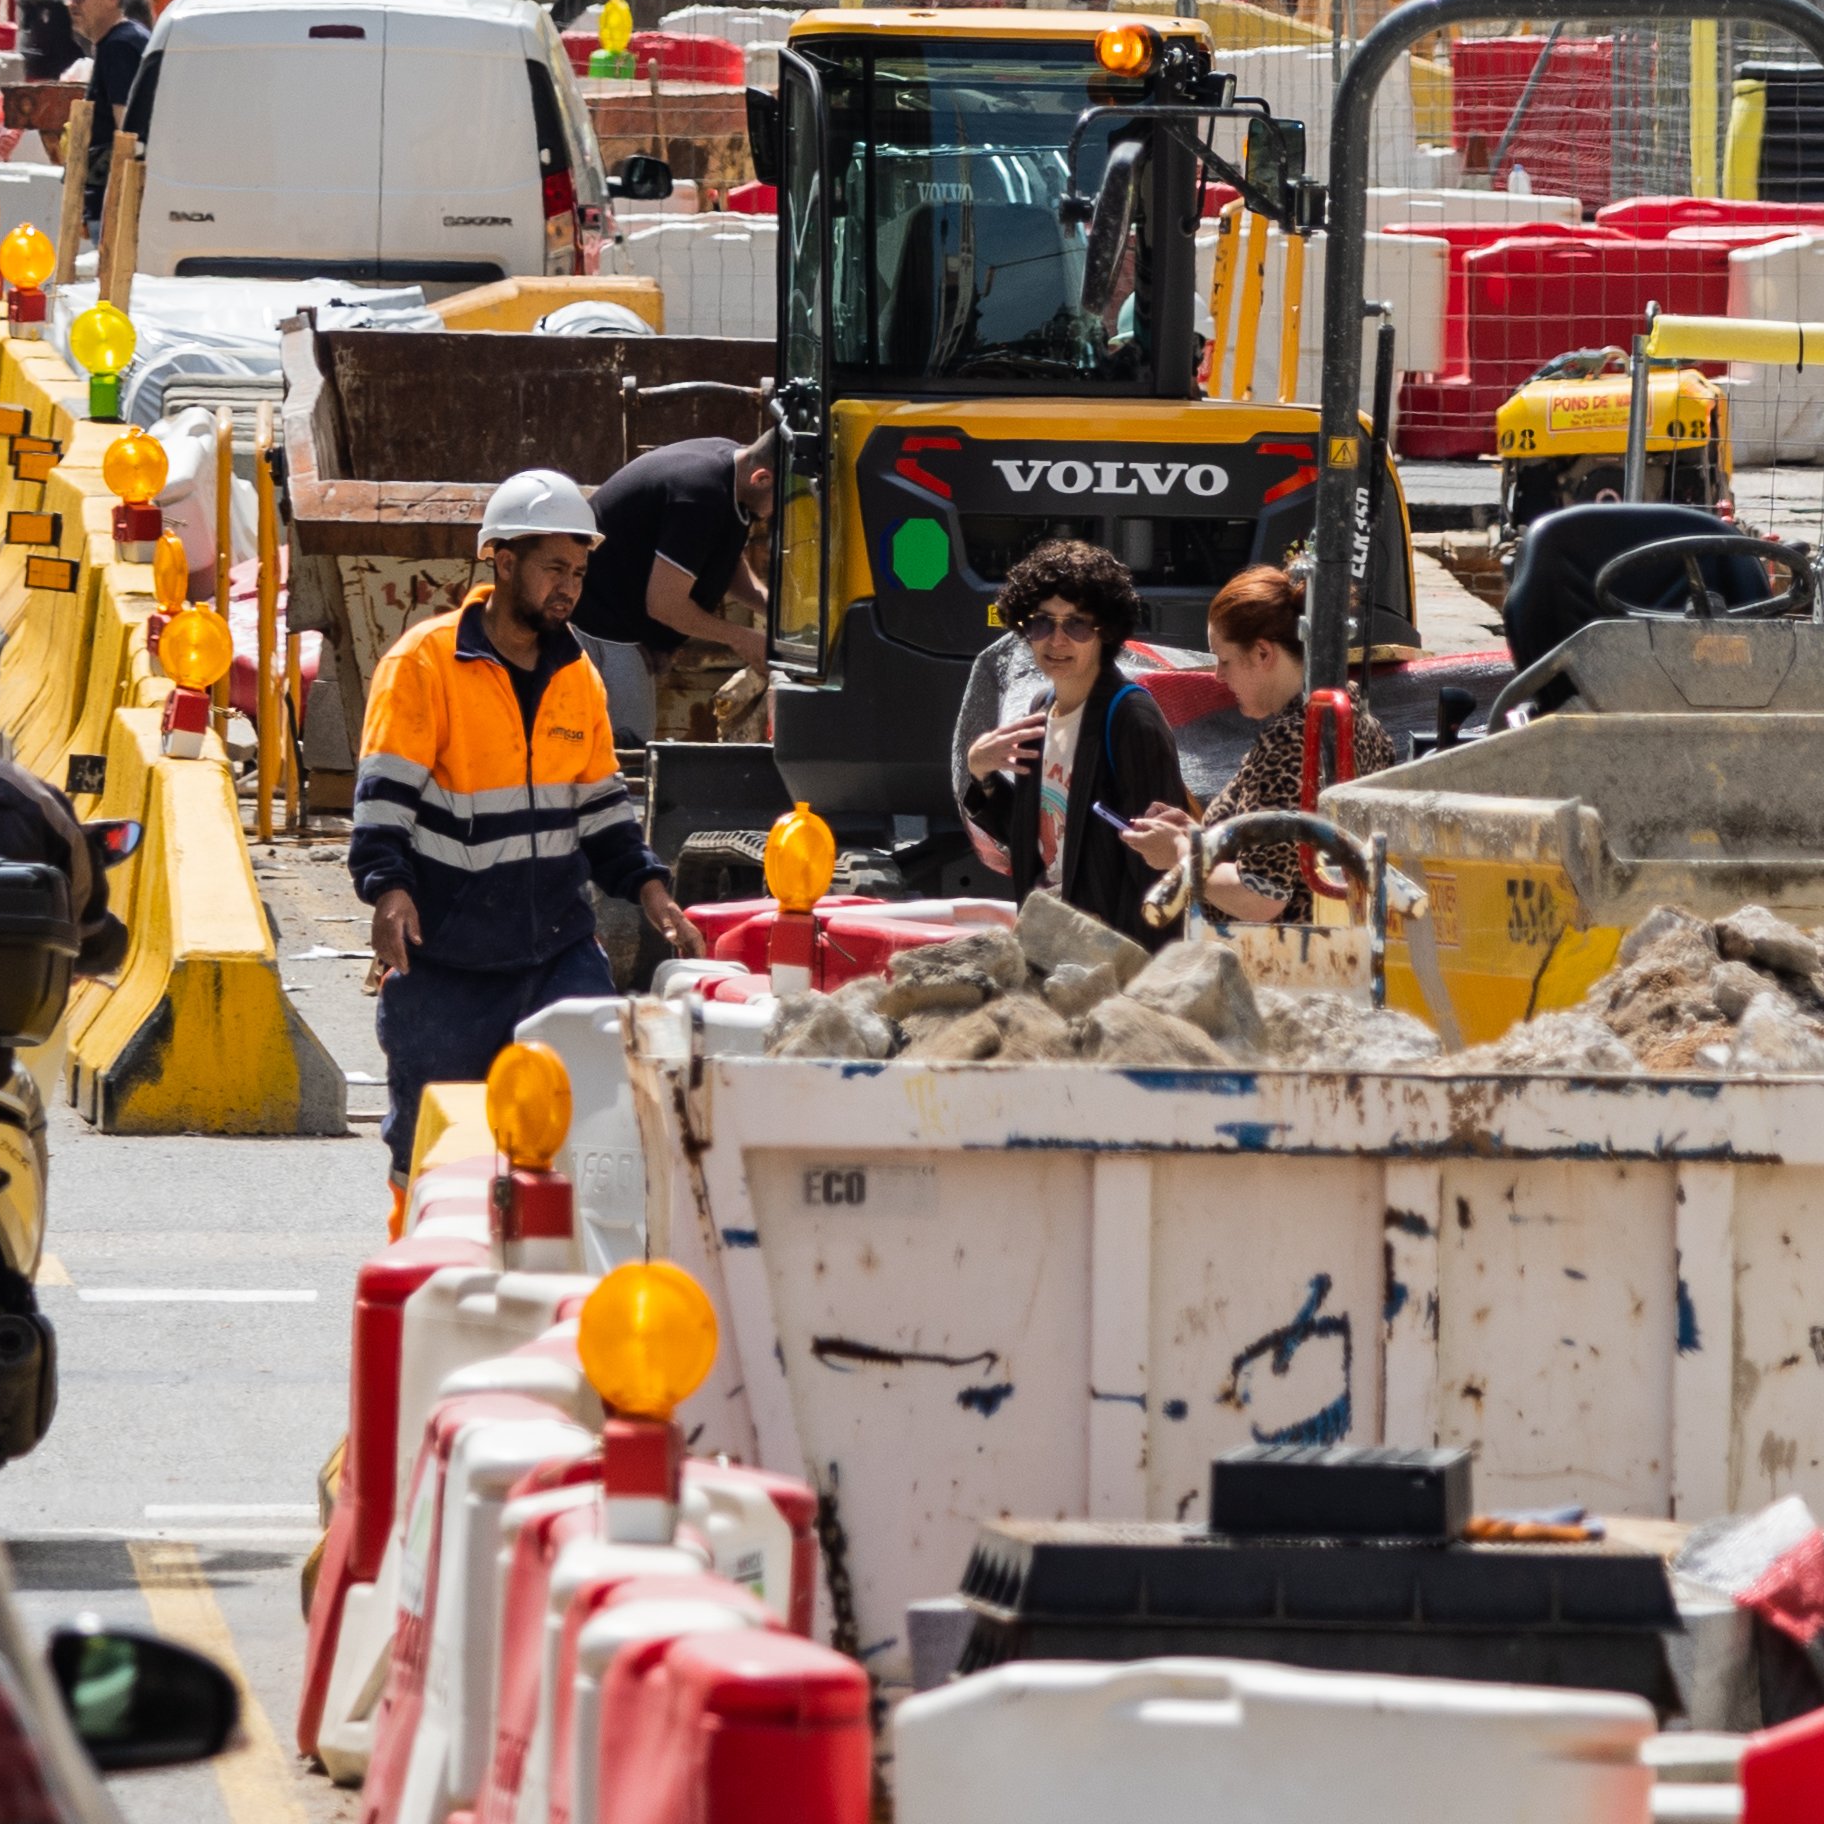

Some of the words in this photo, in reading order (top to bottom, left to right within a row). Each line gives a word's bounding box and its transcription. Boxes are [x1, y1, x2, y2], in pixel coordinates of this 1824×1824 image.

[1554, 396, 1589, 412] PONS
[1593, 395, 1609, 408] DE
[1501, 429, 1537, 451] 08
[1667, 419, 1707, 439] 08
[992, 458, 1230, 496] VOLVO
[805, 1170, 866, 1205] ECO
